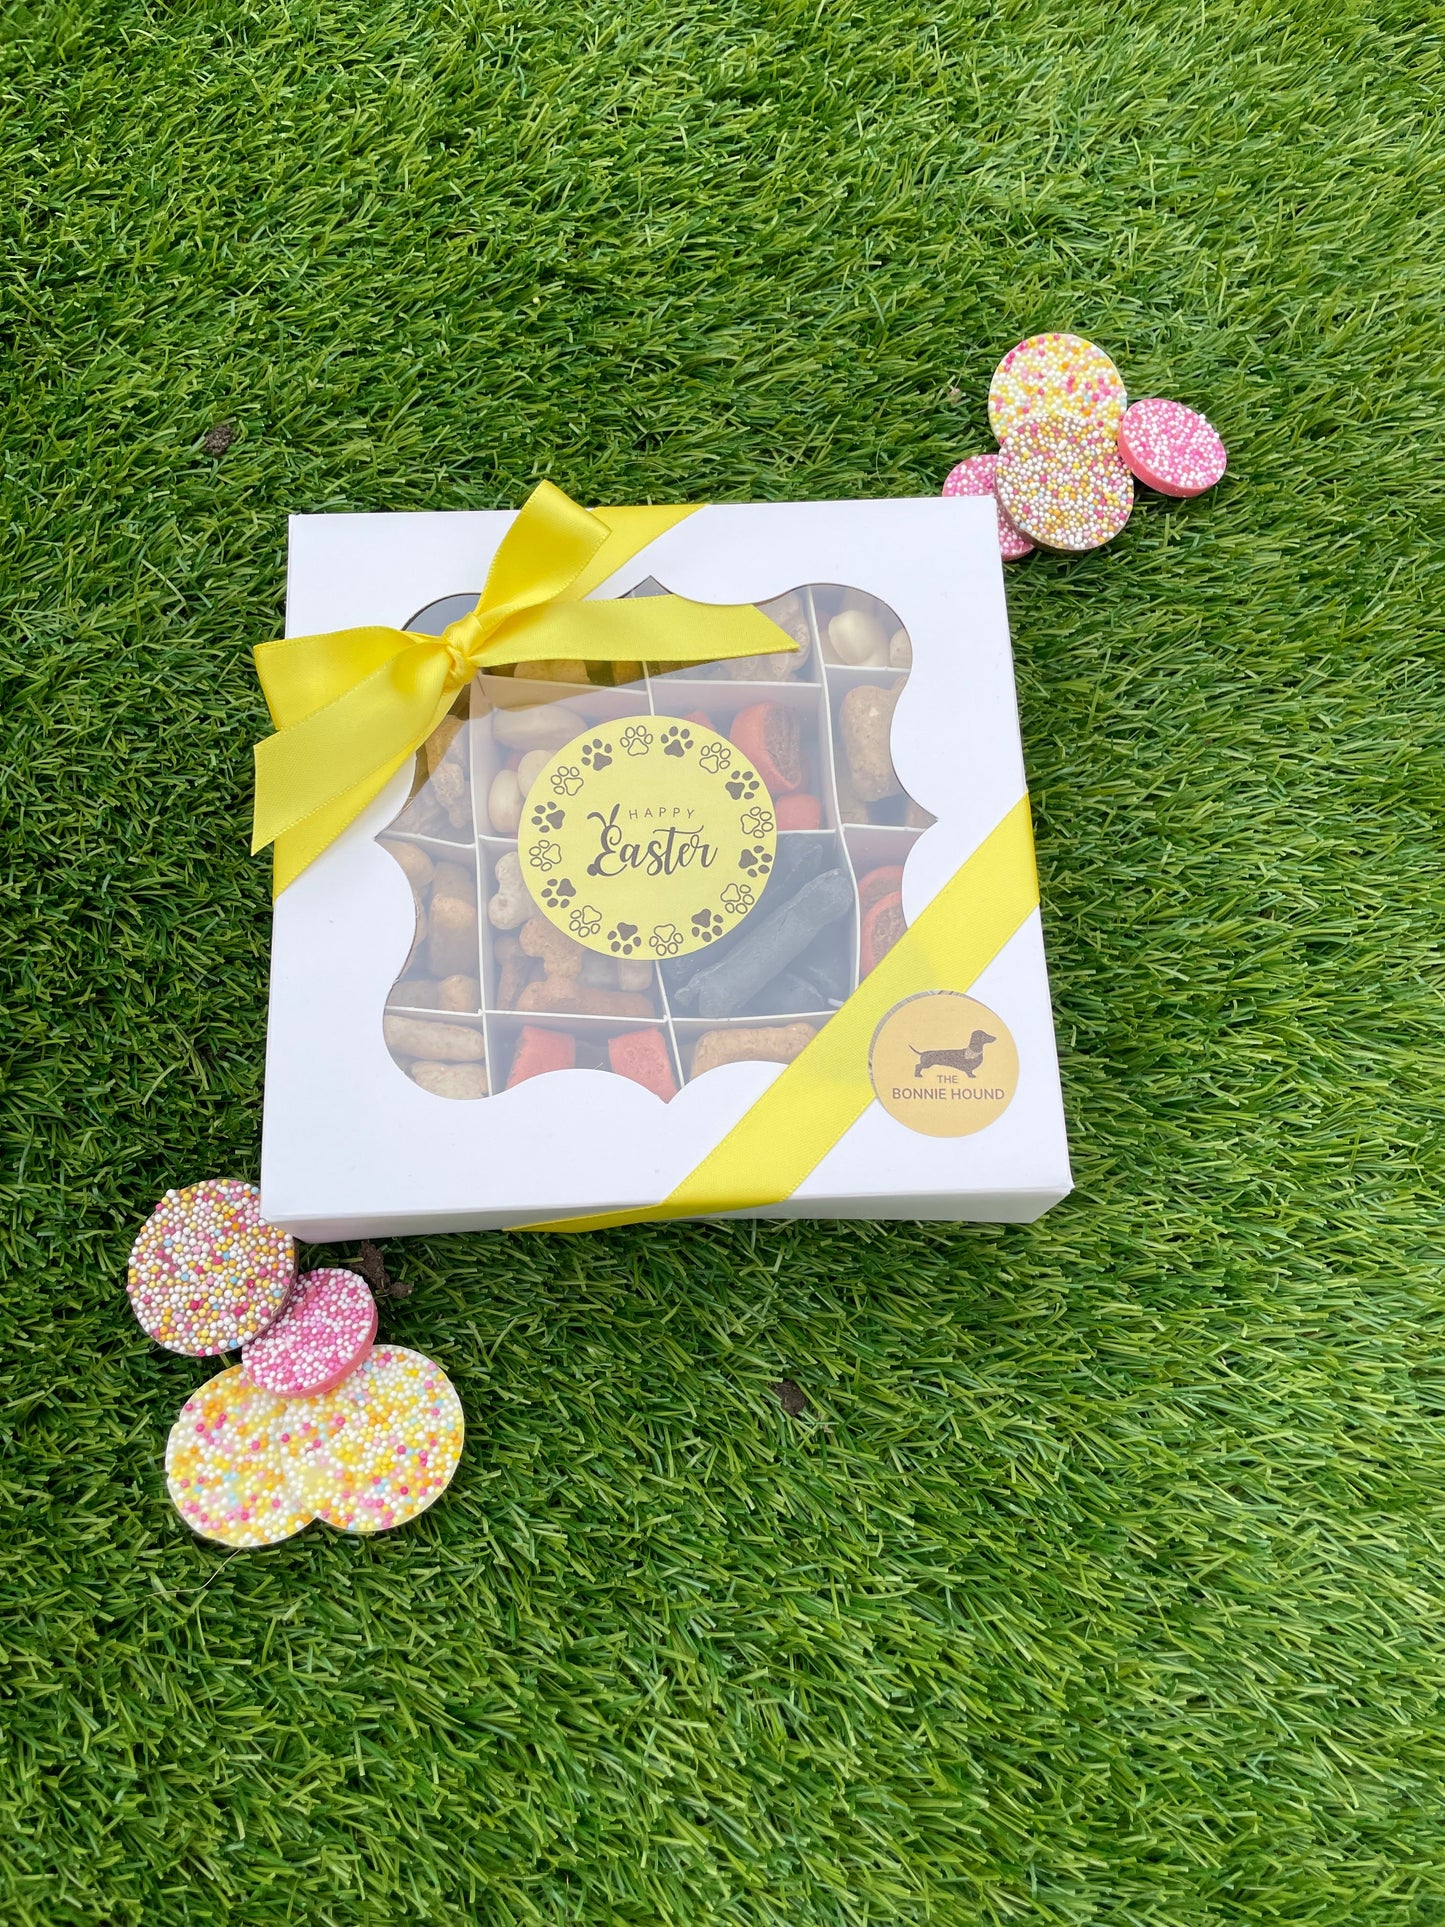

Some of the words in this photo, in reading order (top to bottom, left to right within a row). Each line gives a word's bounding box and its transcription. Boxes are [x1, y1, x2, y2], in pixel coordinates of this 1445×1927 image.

[628, 807, 695, 820] HAPPY
[586, 803, 718, 877] Easter
[936, 1074, 958, 1084] THE
[892, 1087, 947, 1100] BONNIE
[951, 1088, 1005, 1100] HOUND
